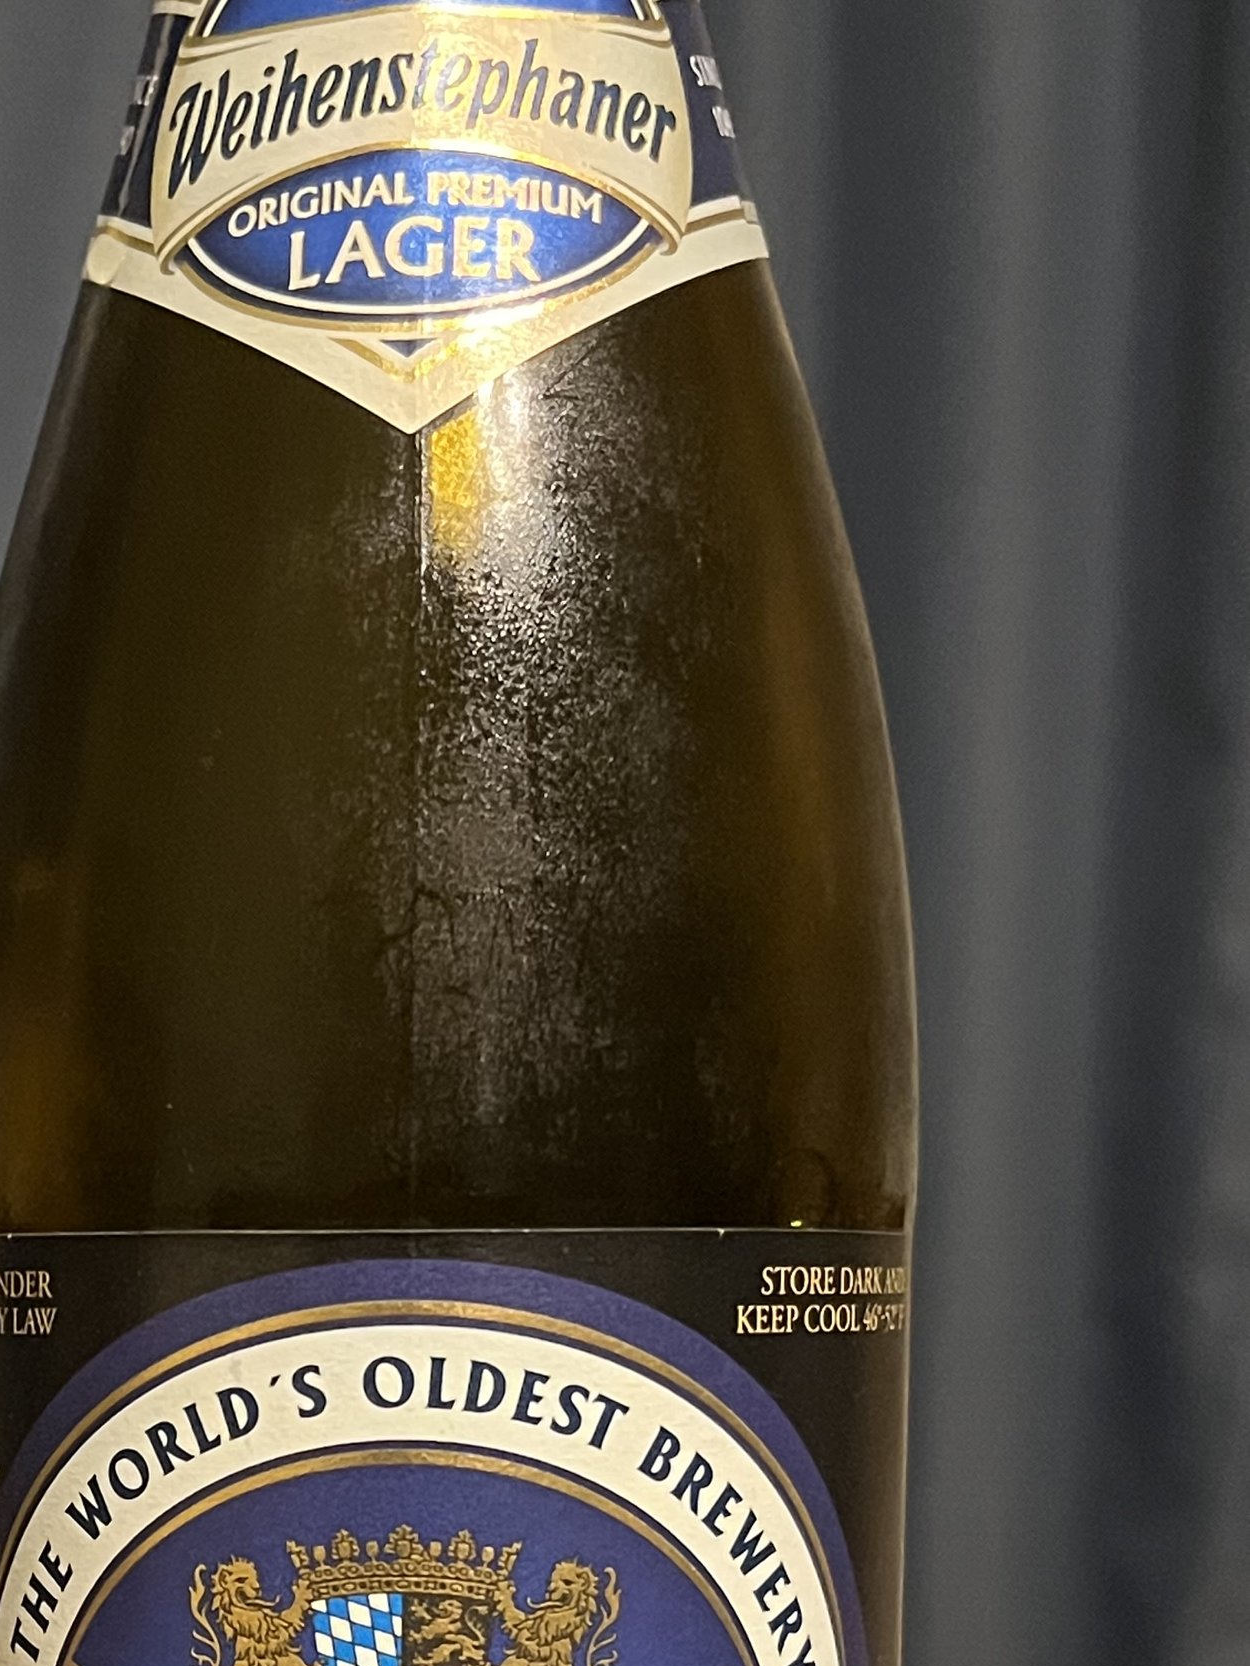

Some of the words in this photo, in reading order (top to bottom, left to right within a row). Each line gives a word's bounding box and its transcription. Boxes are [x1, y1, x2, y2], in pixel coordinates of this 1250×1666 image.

[168, 38, 676, 200] Weihenstephaner
[227, 175, 416, 239] ORIGINAL
[427, 171, 603, 225] PREMIUM
[288, 216, 543, 292] LAGER
[760, 1266, 836, 1296] STORE
[839, 1266, 883, 1295] DARK
[12, 1306, 58, 1335] LAW
[736, 1304, 800, 1335] KEEP
[803, 1303, 861, 1334] COOL
[10, 1540, 75, 1664] THE
[362, 1356, 630, 1450] OLDEST
